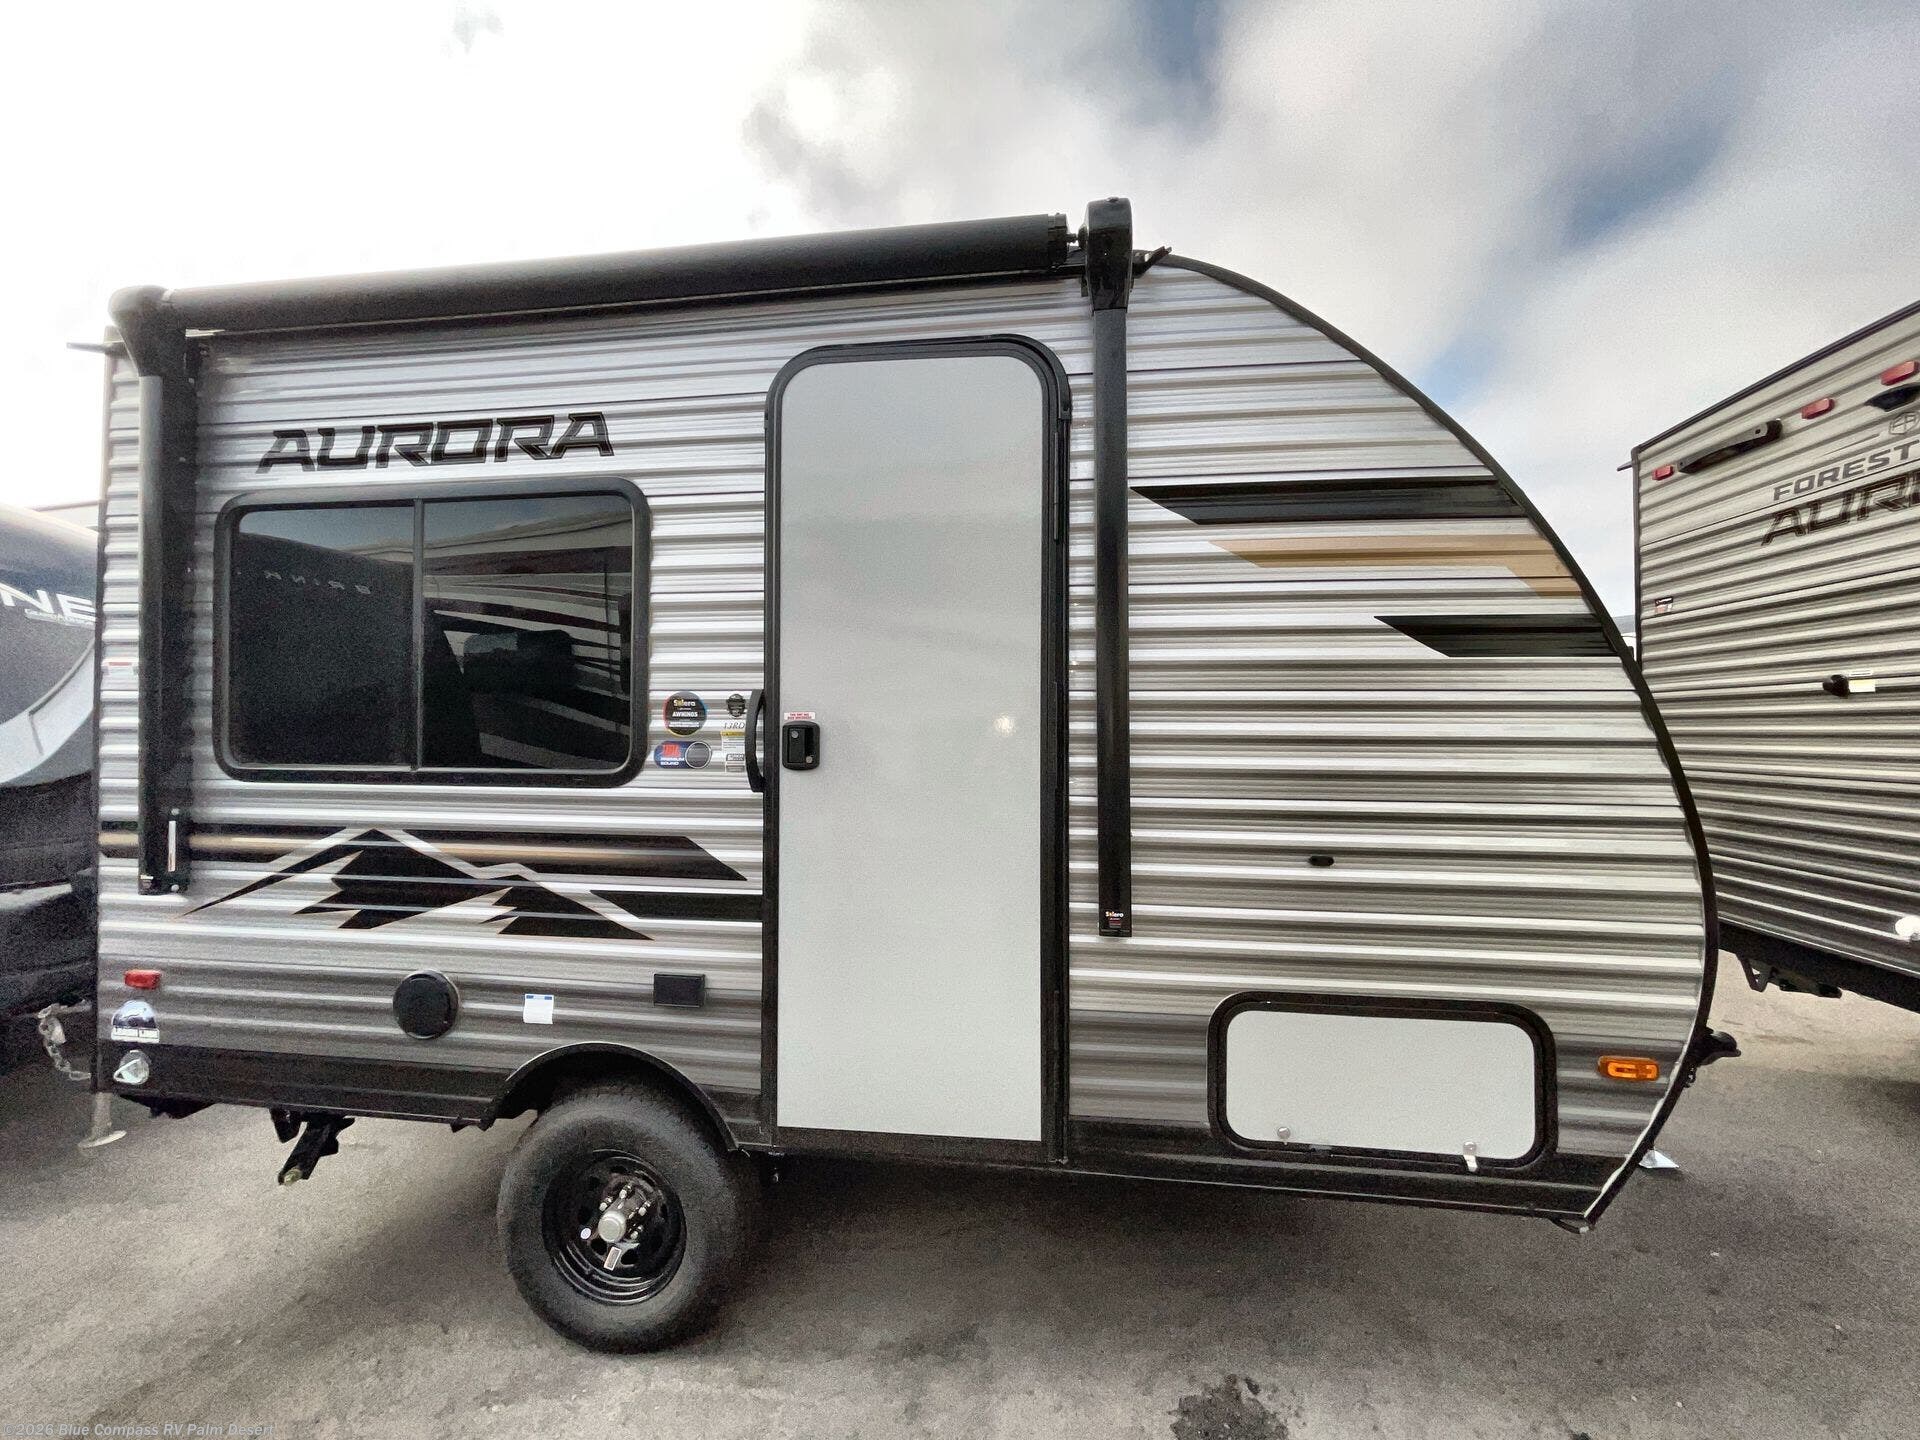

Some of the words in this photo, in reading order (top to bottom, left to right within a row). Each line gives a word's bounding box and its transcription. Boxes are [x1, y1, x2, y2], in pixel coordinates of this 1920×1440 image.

[256, 412, 614, 474] AURORA
[1773, 439, 1920, 501] FOREST
[1761, 469, 1920, 546] AUR
